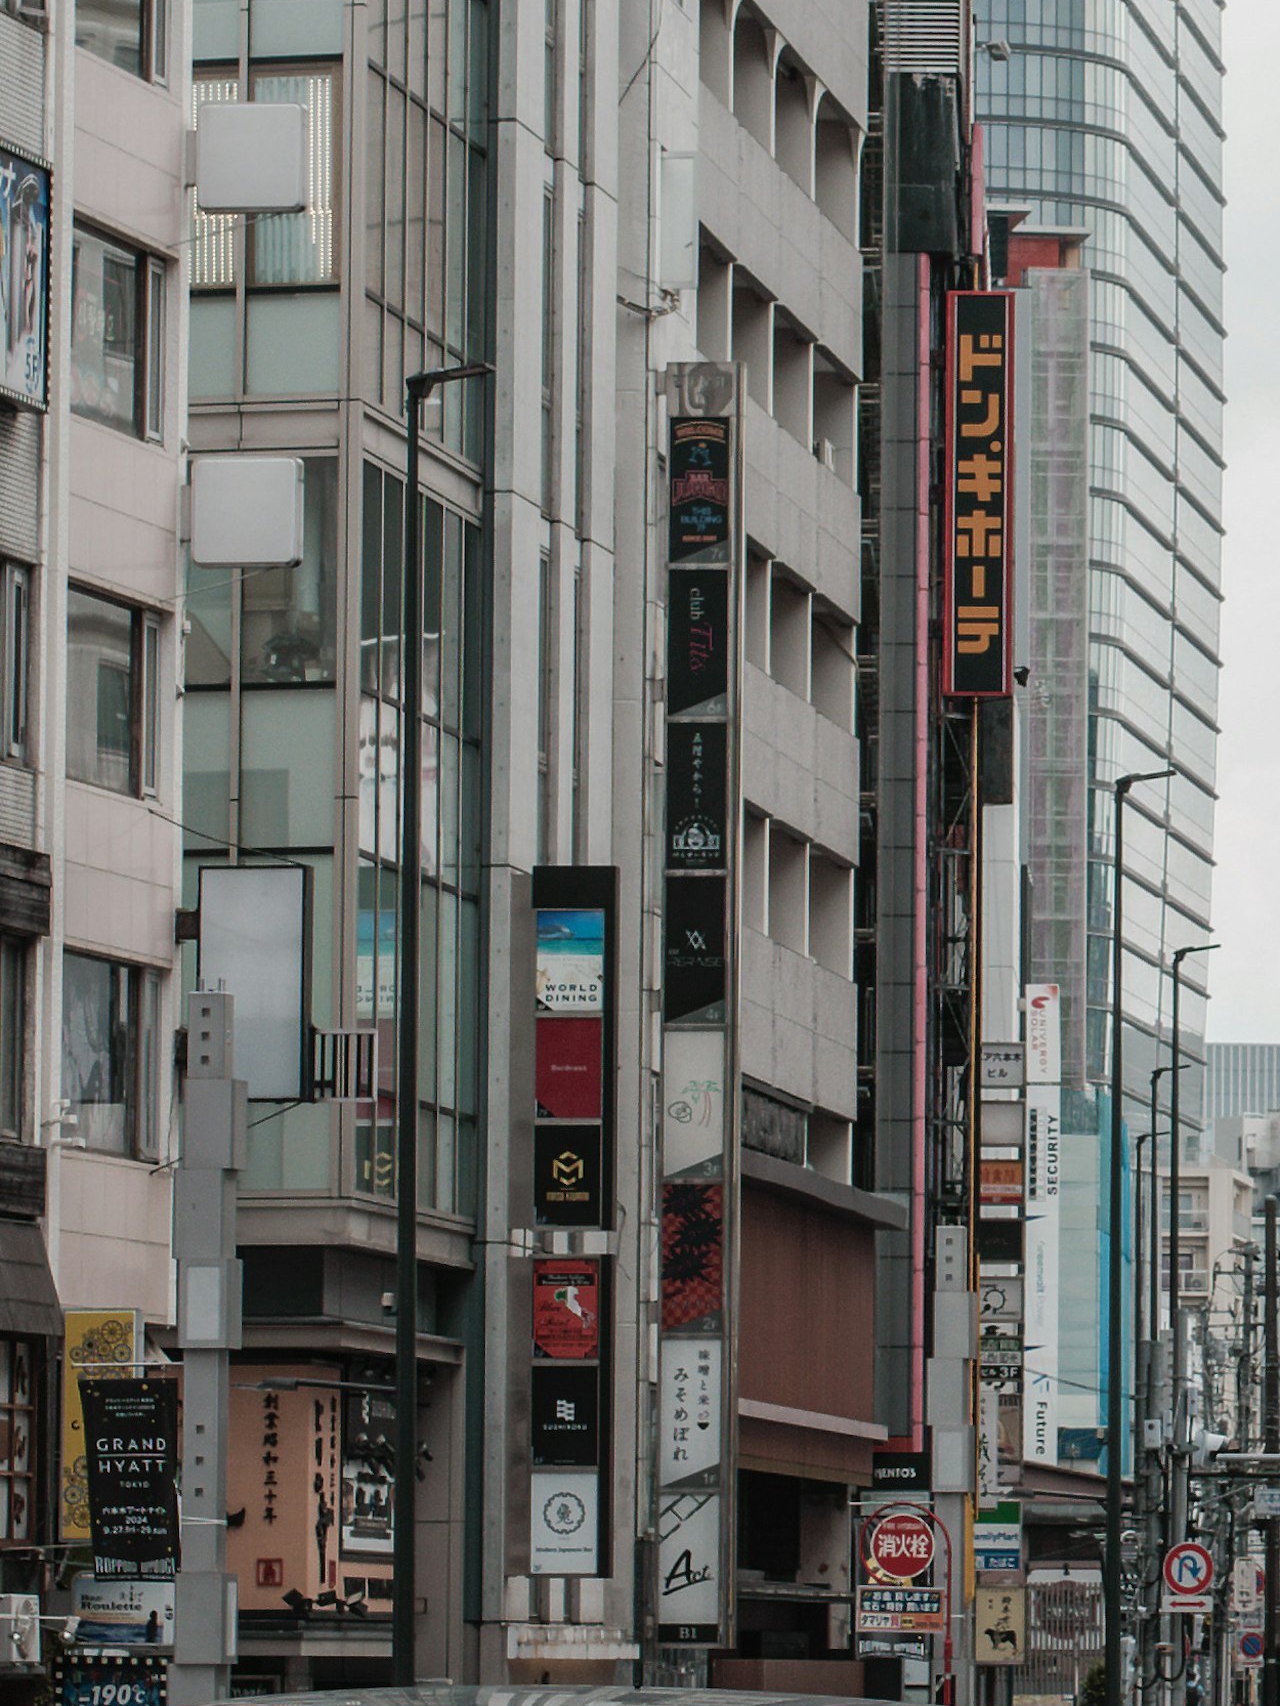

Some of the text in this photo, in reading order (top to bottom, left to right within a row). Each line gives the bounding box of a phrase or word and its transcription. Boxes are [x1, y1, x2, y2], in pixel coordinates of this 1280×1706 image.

[545, 984, 597, 992] WORLD
[545, 994, 597, 1002] DINING
[987, 1068, 1008, 1078] ビル
[1047, 1115, 1058, 1195] SECURITY
[703, 1161, 720, 1177] 3F
[1035, 1401, 1048, 1455] Future
[96, 1438, 167, 1451] GRAND
[98, 1460, 167, 1473] HYATT
[120, 1480, 149, 1489] TOKYO
[878, 1534, 929, 1558] 消火栓
[989, 1557, 1016, 1568] たばこ
[81, 1601, 142, 1611] Roulette
[679, 1627, 697, 1639] B1
